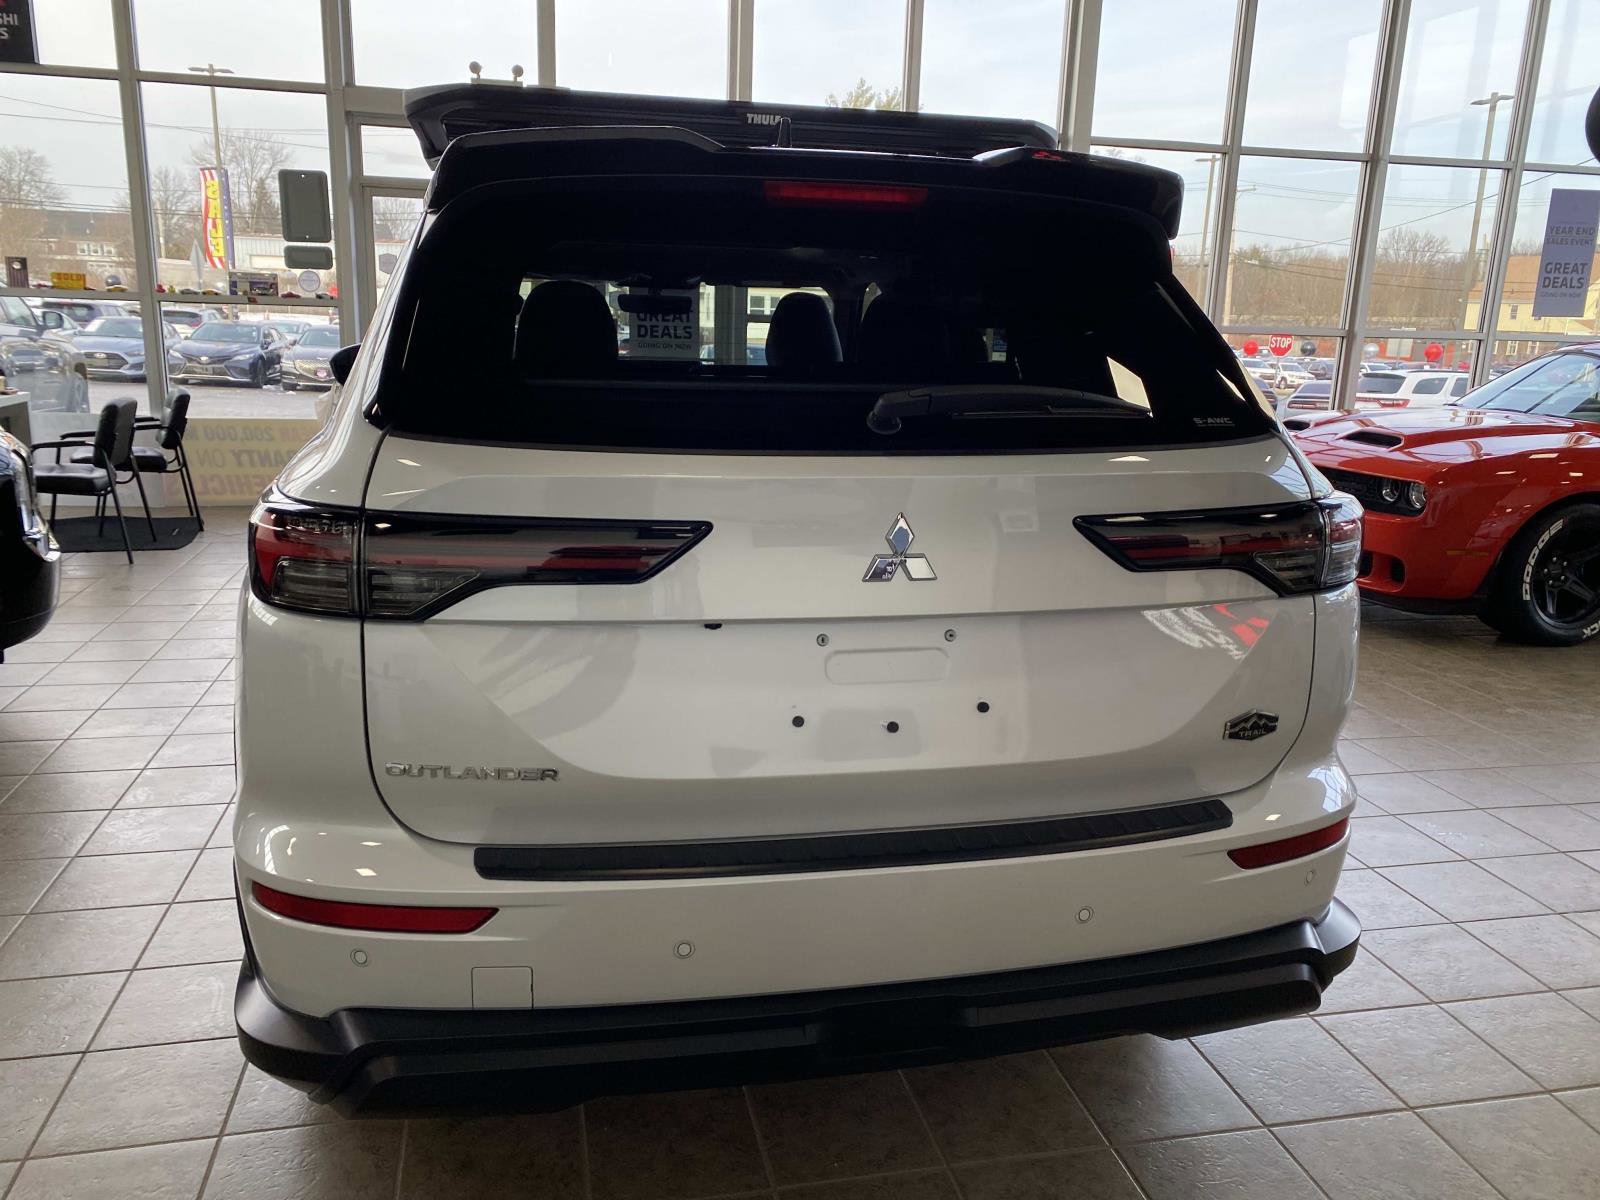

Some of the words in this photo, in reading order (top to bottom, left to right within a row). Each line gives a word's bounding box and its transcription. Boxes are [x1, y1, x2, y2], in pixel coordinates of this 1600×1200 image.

[1550, 225, 1574, 235] YEAR
[1575, 226, 1595, 236] END
[1546, 237, 1569, 246] SALES
[1545, 262, 1588, 275] GREAT
[1542, 276, 1585, 289] DEALS
[637, 324, 692, 340] DEALS
[1271, 336, 1292, 349] STOP
[1522, 519, 1564, 601] DODGE
[385, 762, 560, 782] OUTLANDER
